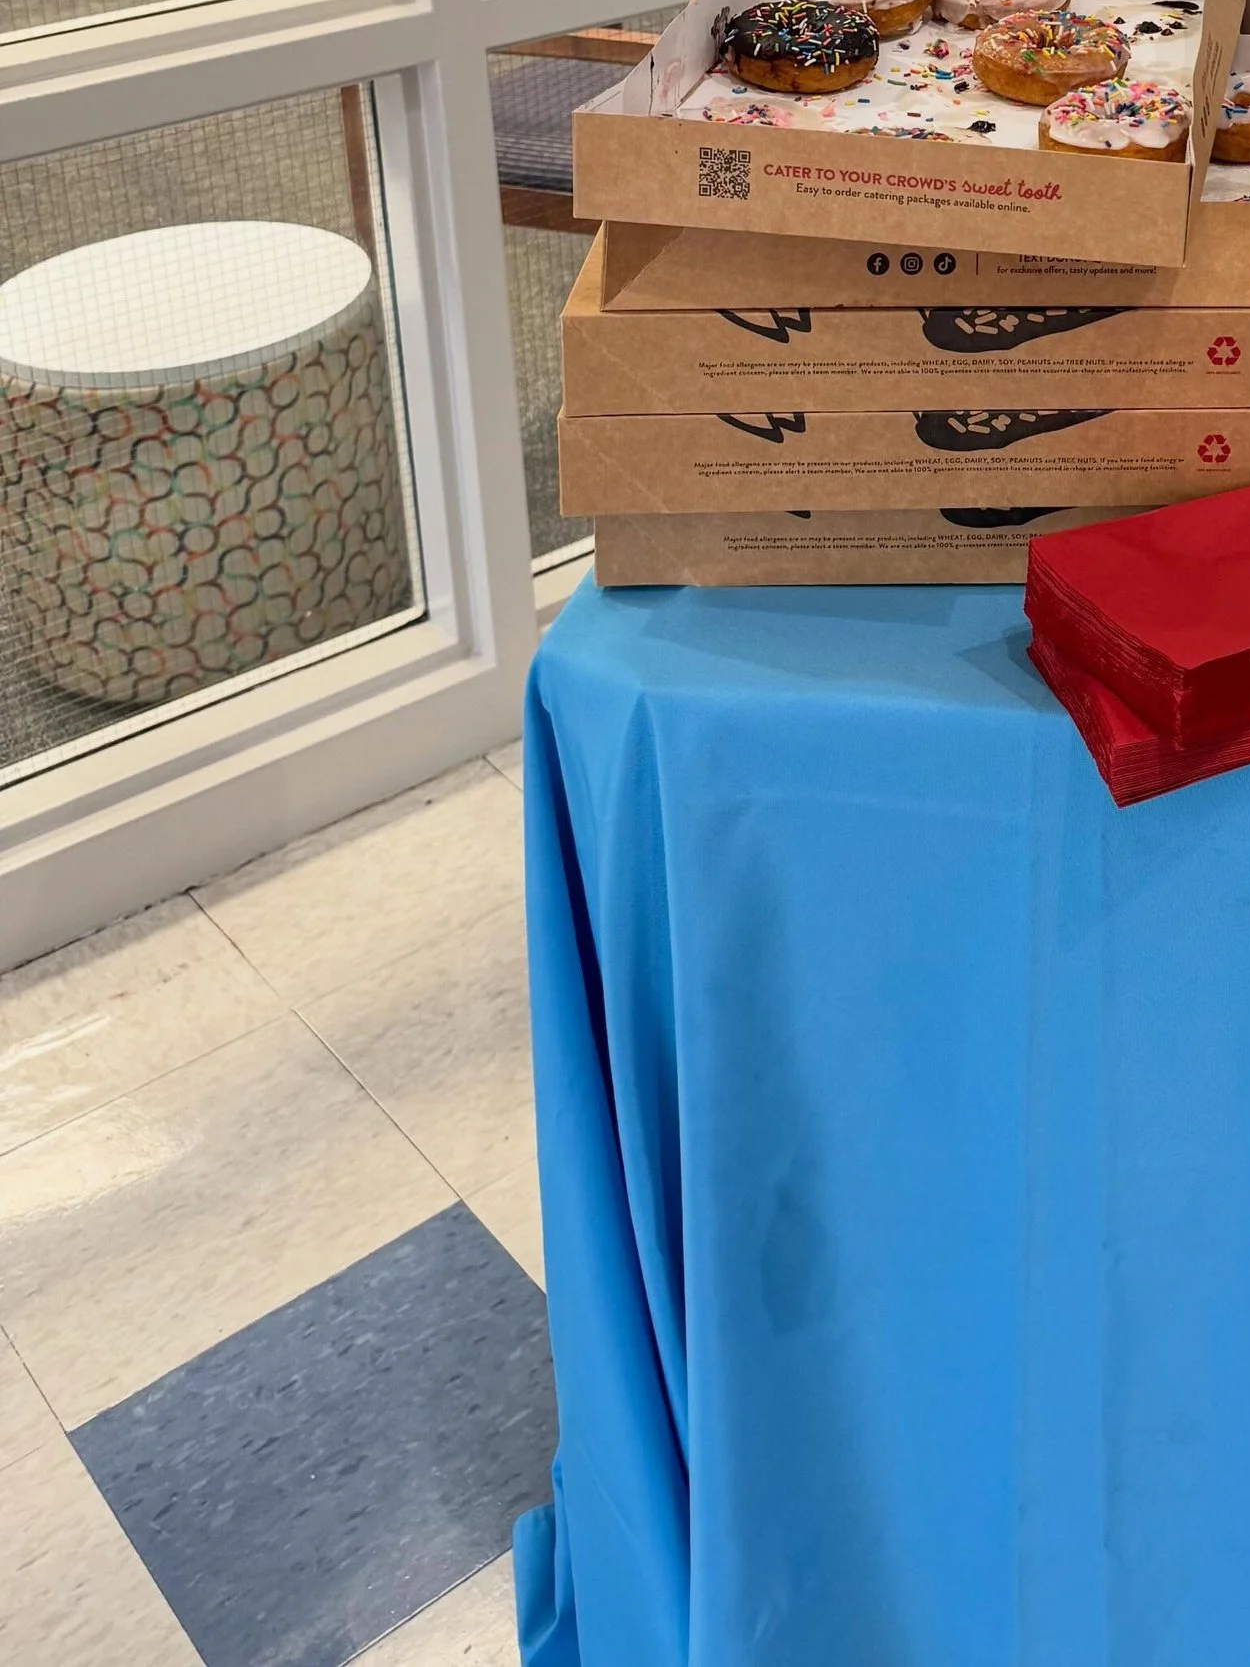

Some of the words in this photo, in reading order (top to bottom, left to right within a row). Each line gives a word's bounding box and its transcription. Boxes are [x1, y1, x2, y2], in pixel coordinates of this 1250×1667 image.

[763, 164, 812, 179] CATER
[816, 168, 835, 181] TO
[840, 170, 882, 185] YOUR
[886, 174, 956, 192] CROWD'S
[962, 178, 1012, 196] sweet
[1018, 180, 1062, 200] tooth
[796, 183, 819, 197] Easy
[822, 186, 832, 195] to
[835, 187, 862, 198] order
[864, 190, 904, 205] catering
[906, 194, 951, 209] packages
[953, 198, 995, 210] available
[997, 202, 1031, 213] online.
[997, 265, 1009, 274] for
[1010, 266, 1043, 274] exclusive
[1044, 266, 1068, 275] offers,
[1070, 266, 1088, 276] tasty
[1089, 266, 1118, 277] updates
[1120, 266, 1134, 274] and
[1134, 266, 1156, 274] more!
